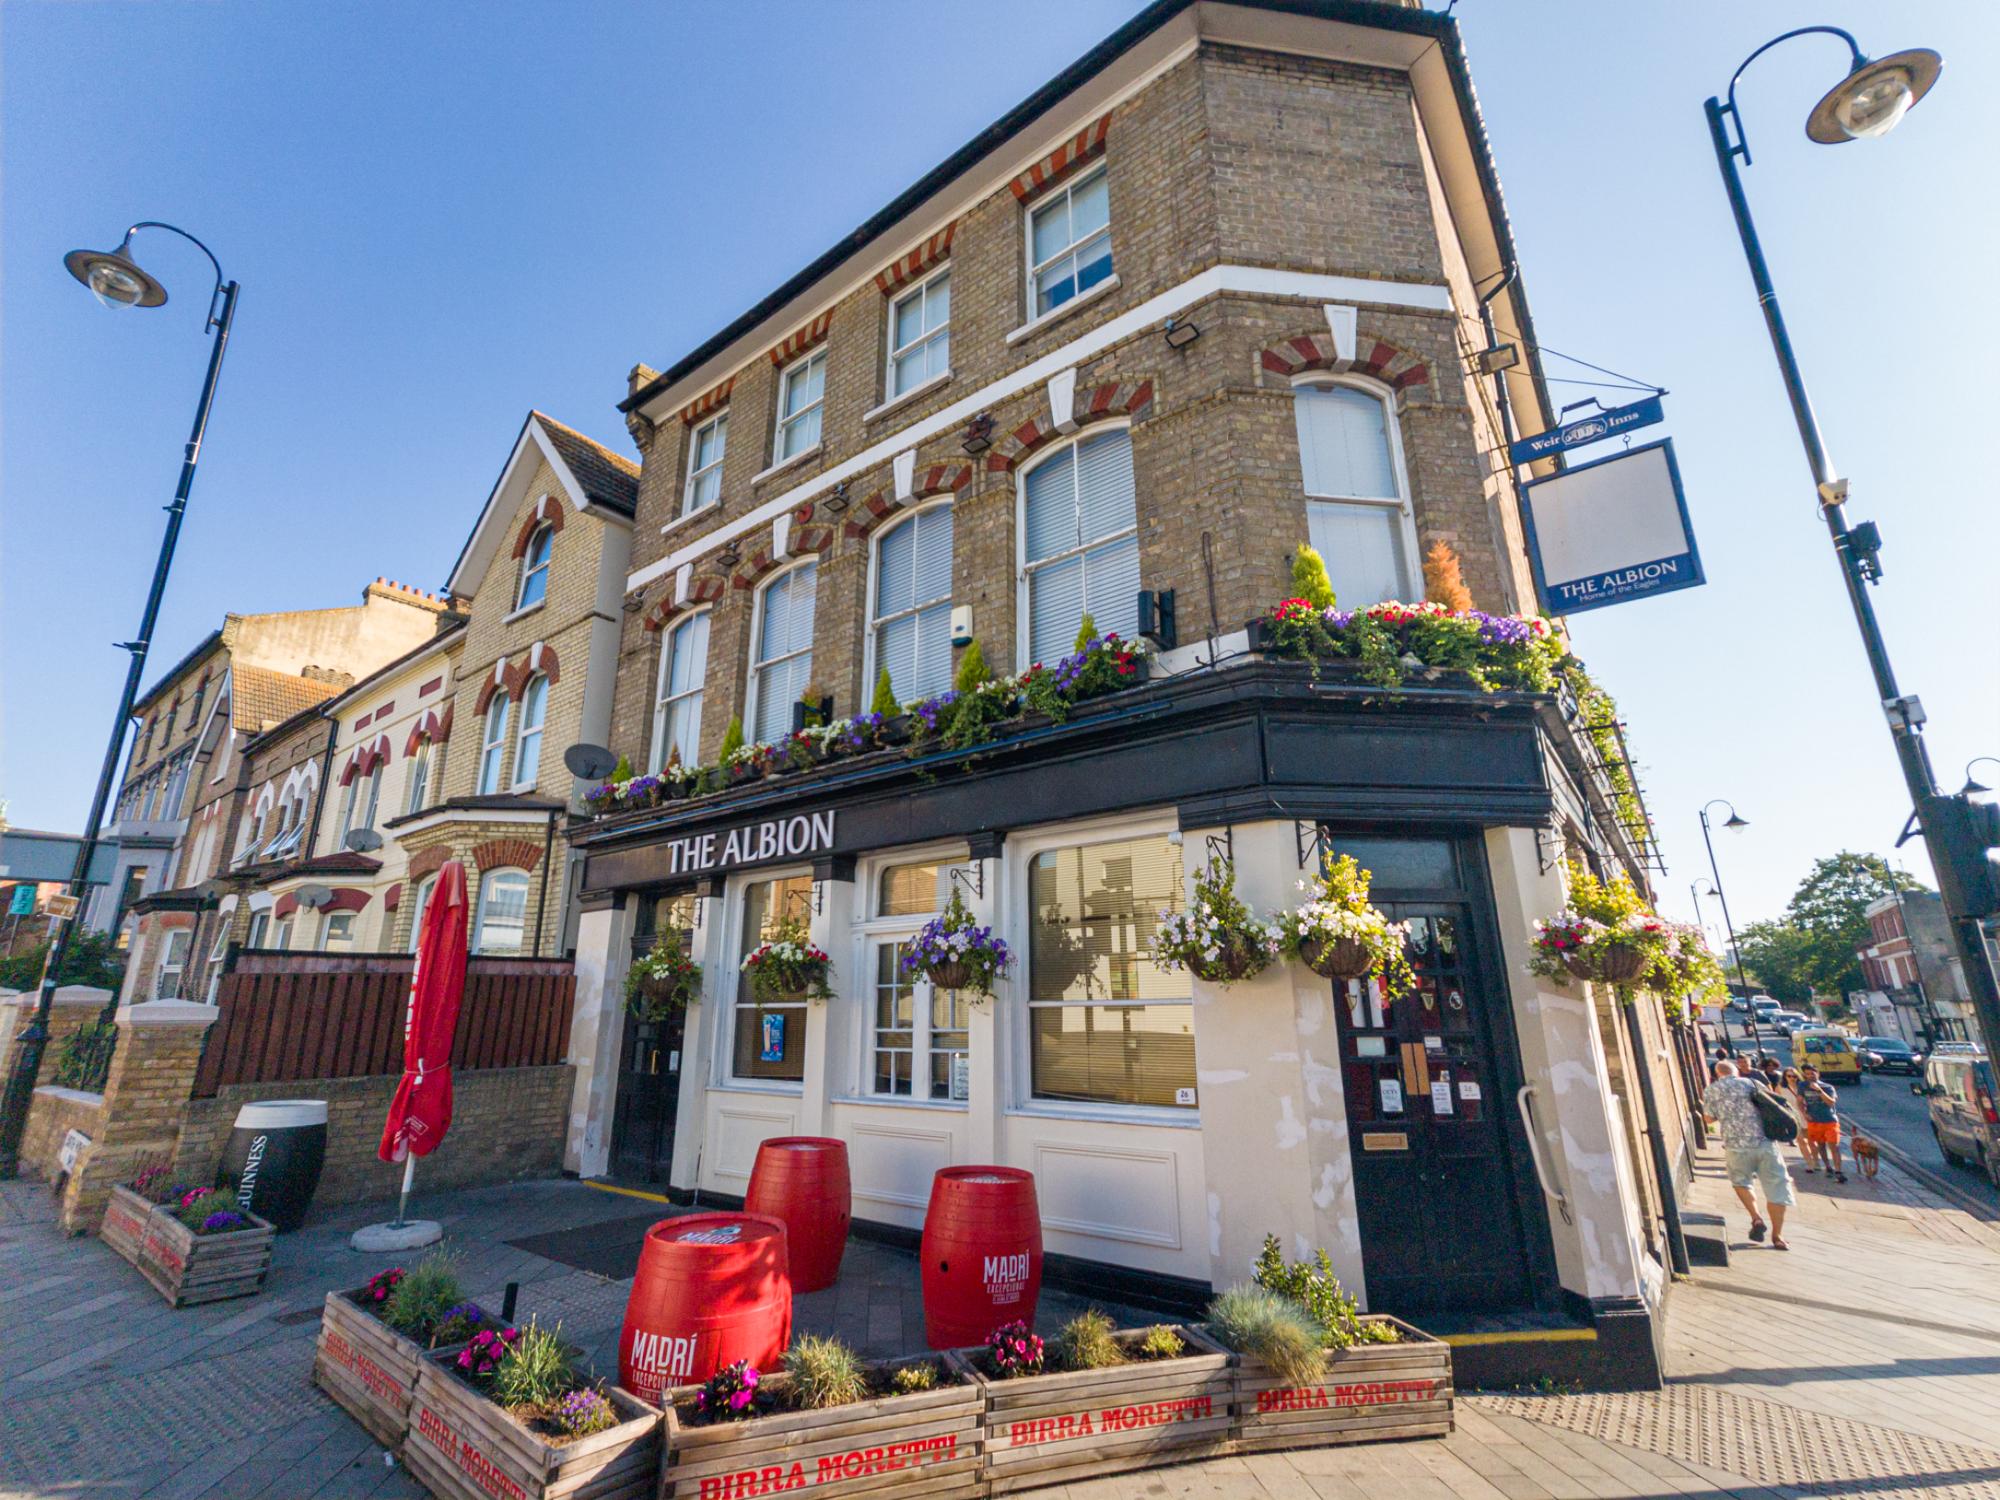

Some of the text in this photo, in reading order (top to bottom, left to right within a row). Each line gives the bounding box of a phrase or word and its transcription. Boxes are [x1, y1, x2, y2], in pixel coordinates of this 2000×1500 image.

[1531, 412, 1639, 451] Weir Inns
[1560, 560, 1677, 598] THE ALBION
[1580, 578, 1660, 602] Home of the Eagles
[668, 810, 836, 873] THE ALBION
[630, 1329, 698, 1376] MADRÍ
[1256, 1379, 1435, 1412] BIRRA MORETTI
[420, 1408, 457, 1460] BIRRA
[1010, 1396, 1212, 1447] BIRRA MORETTI
[699, 1434, 957, 1500] BIRRA MORETTI
